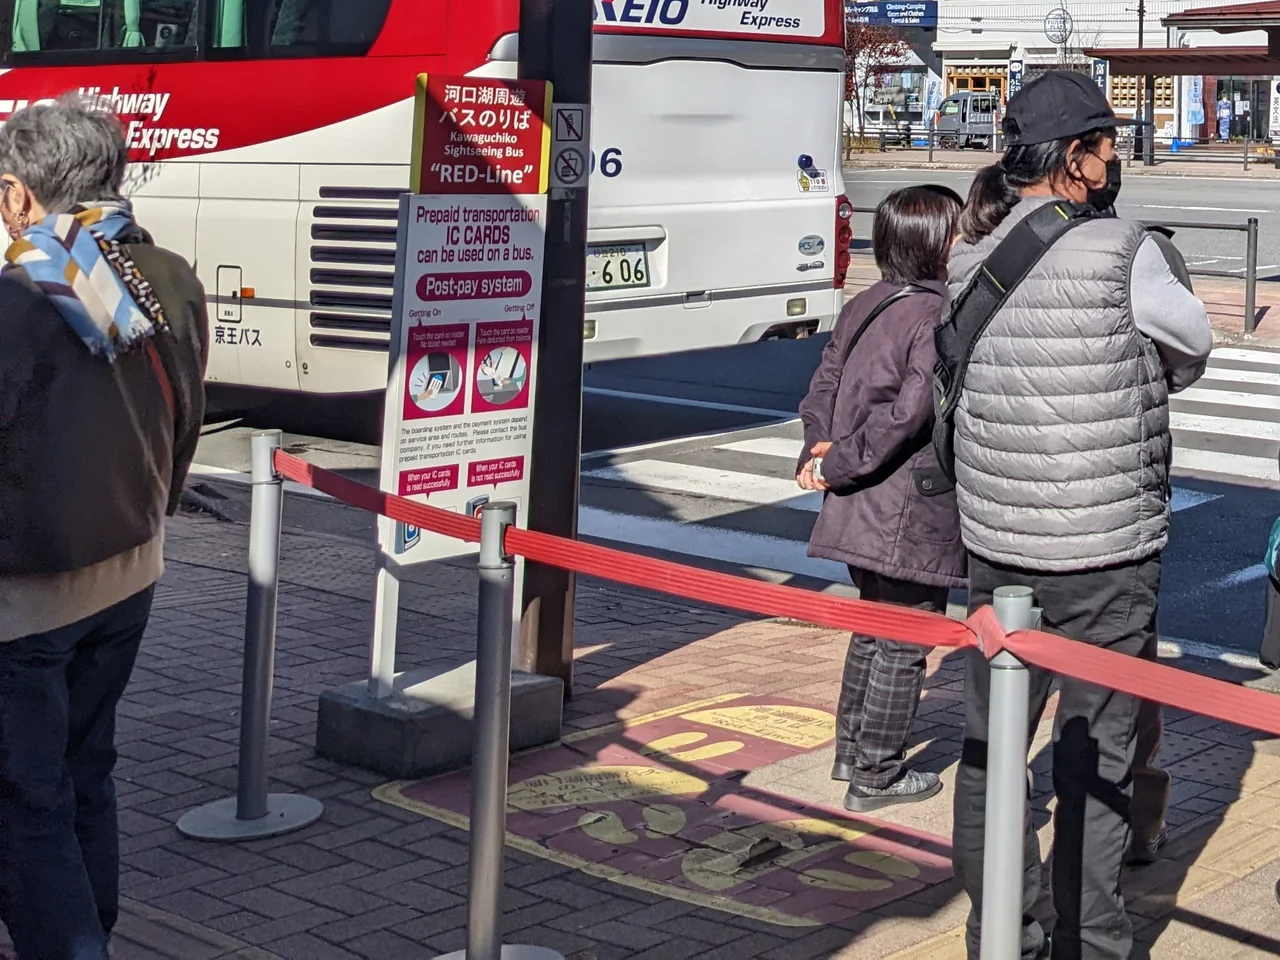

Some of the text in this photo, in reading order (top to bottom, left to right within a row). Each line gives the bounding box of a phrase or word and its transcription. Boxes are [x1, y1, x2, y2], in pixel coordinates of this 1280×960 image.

[740, 11, 801, 30] Express
[444, 84, 526, 107] 河口湖周遊
[439, 108, 532, 130] バスのりば
[126, 121, 220, 156] Express
[450, 131, 518, 145] Kawaguchiko
[444, 145, 524, 159] Sightseeing Bus
[416, 206, 540, 225] Prepaid transportation
[446, 225, 510, 246] IC CARDS
[417, 244, 534, 264] can be used on a bus.
[426, 276, 523, 297] Post-pay system
[409, 308, 441, 319] Getting On
[504, 303, 535, 314] Getting Off
[215, 325, 262, 347] 京王バス
[401, 416, 528, 436] The boarding system and the payment system depend
[407, 435, 427, 445] service
[428, 434, 440, 442] area
[441, 432, 450, 440] and
[473, 429, 490, 437] Please
[490, 427, 508, 435] contact
[518, 424, 527, 432] bus
[431, 443, 442, 453] you
[442, 441, 456, 450] need
[456, 439, 475, 448] further
[475, 435, 504, 445] information
[513, 433, 527, 441] using
[399, 453, 418, 464] prepaid
[419, 448, 455, 460] transportation
[489, 459, 517, 472] your cards
[421, 471, 432, 482] your
[423, 477, 451, 490] successfully
[494, 468, 521, 480] successfully
